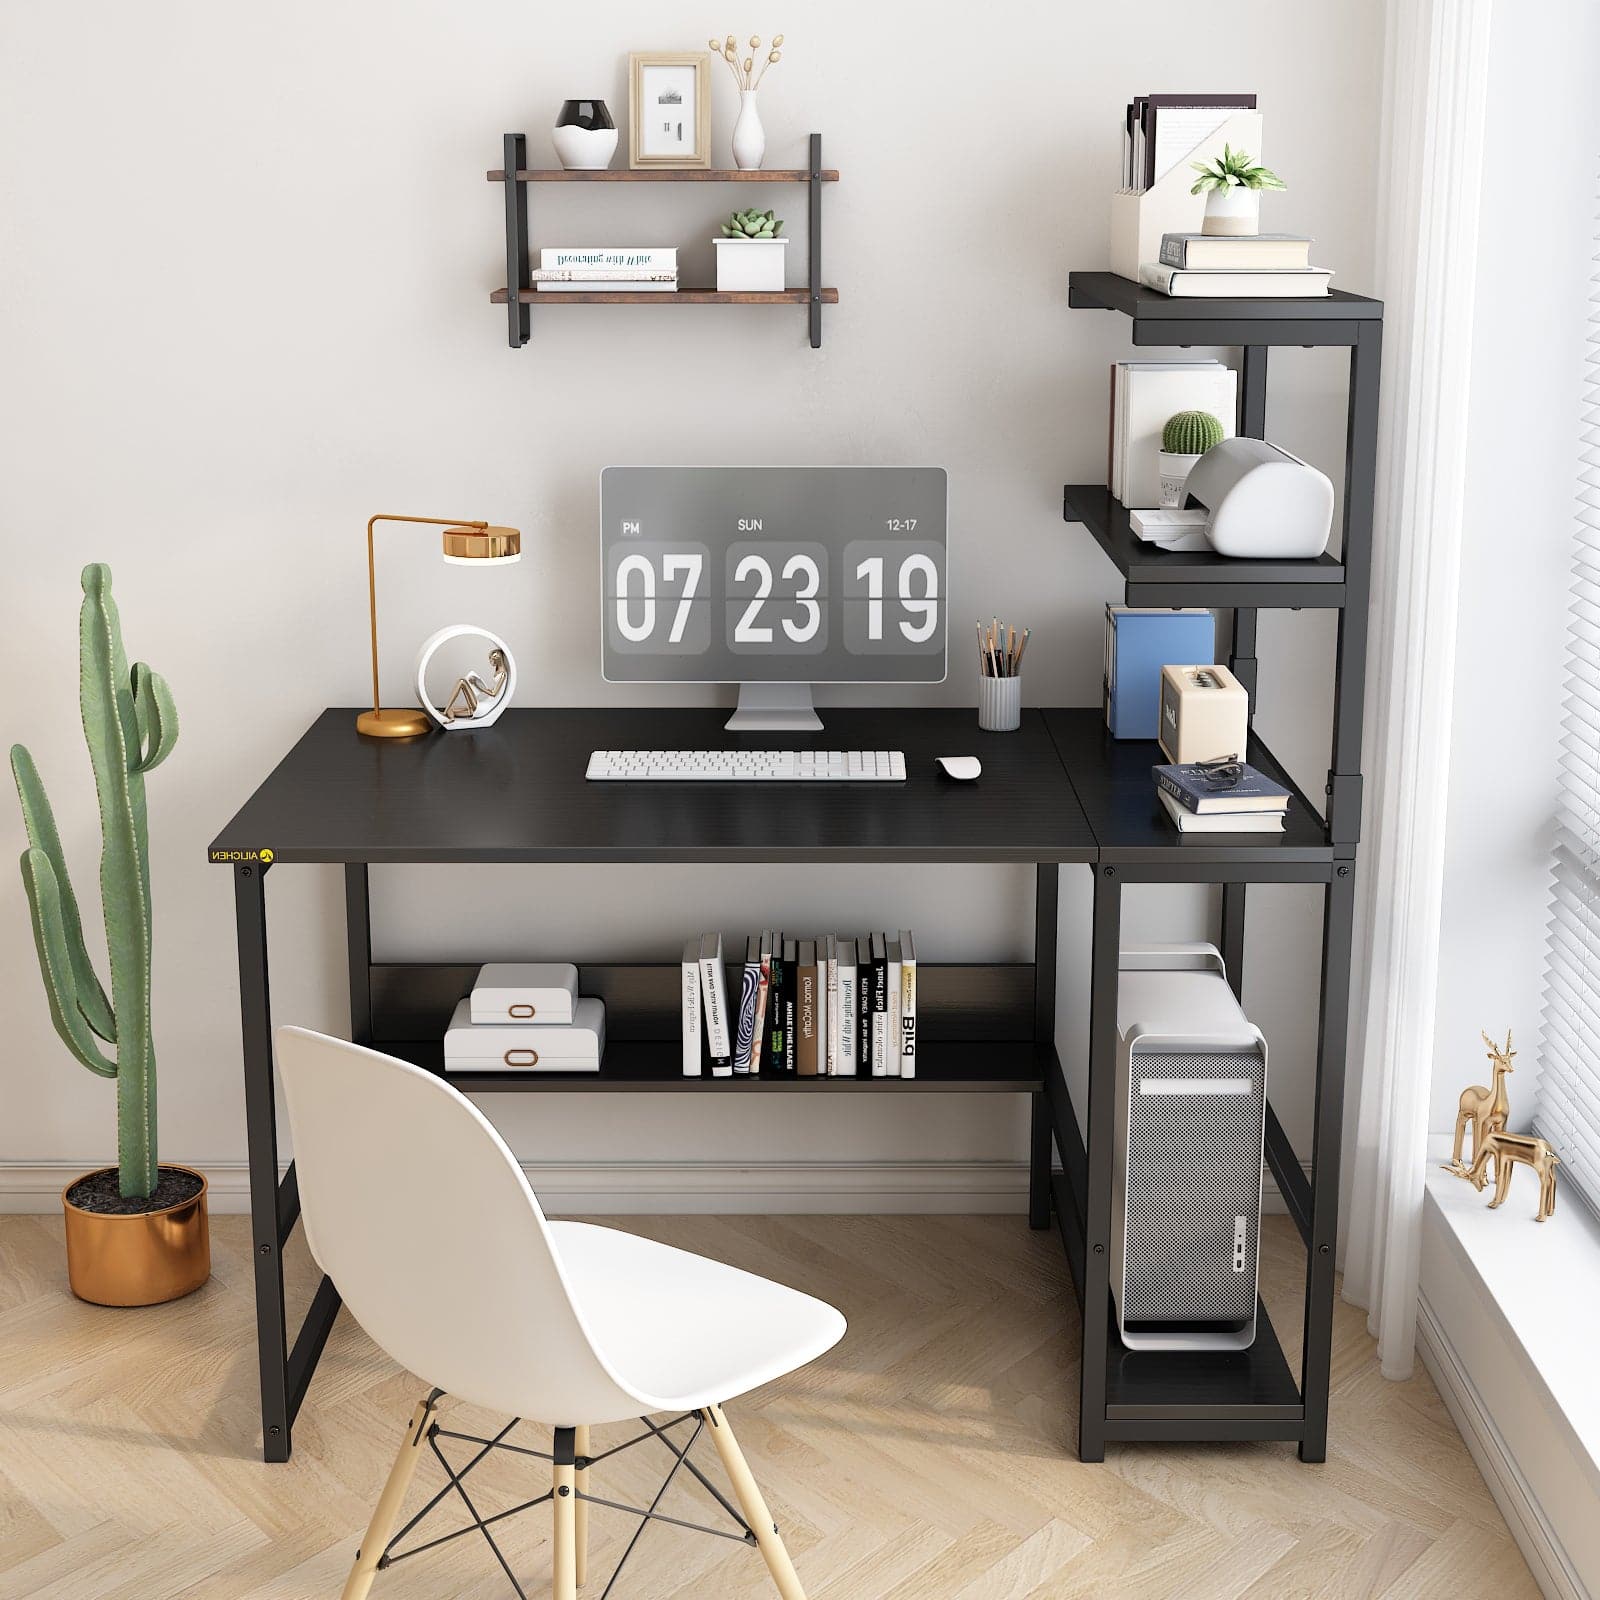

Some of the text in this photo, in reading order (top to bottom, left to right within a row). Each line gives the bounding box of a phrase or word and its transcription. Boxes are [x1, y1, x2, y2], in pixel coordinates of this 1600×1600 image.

[623, 522, 639, 533] PM
[738, 520, 763, 530] SUN
[887, 520, 917, 531] 12-17
[616, 554, 938, 643] 07 23 19
